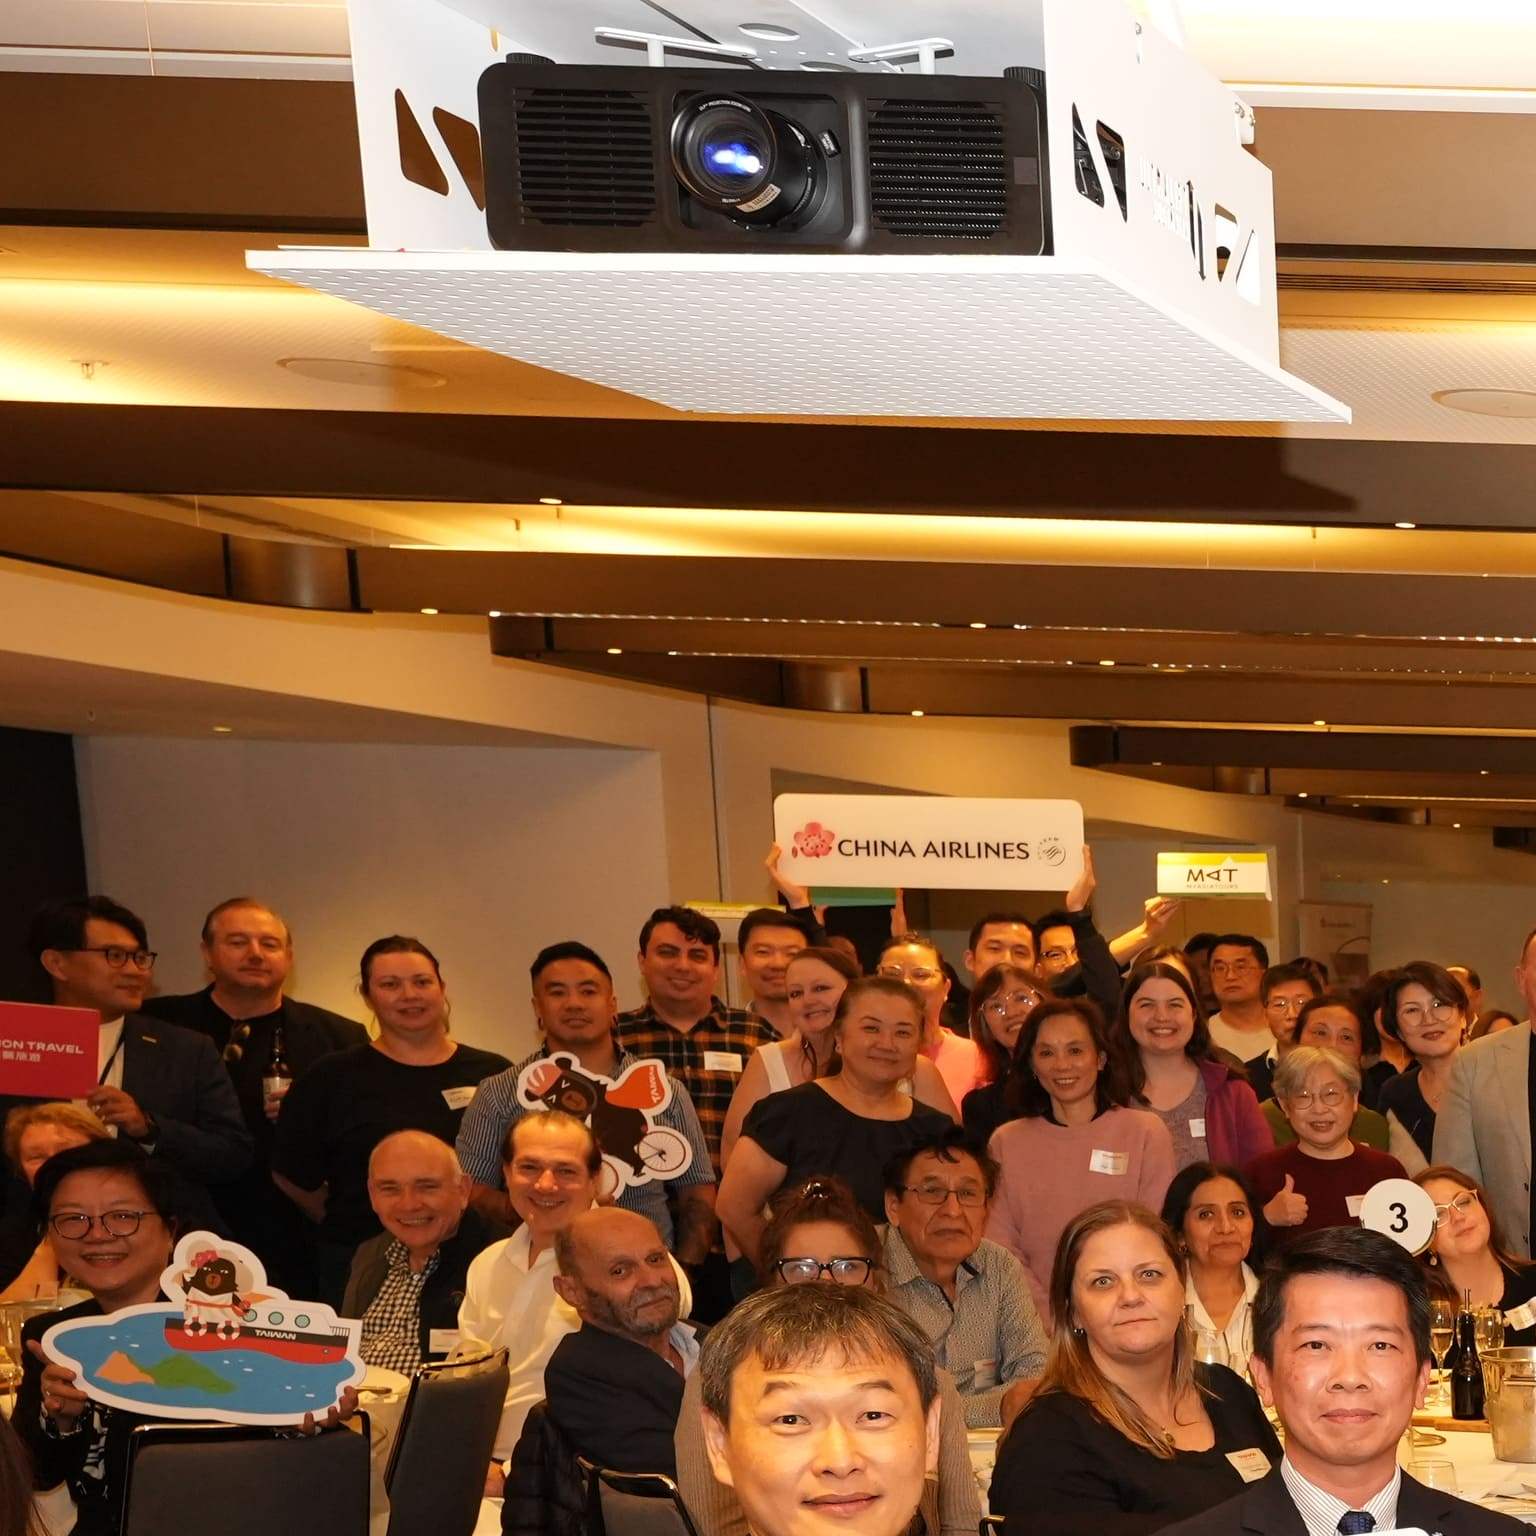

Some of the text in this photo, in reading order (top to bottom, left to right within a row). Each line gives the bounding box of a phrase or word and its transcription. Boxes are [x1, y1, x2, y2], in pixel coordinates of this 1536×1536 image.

[838, 839, 916, 857] CHINA
[922, 841, 1030, 860] AIRLINES
[0, 1039, 84, 1054] ON TRAVEL
[1389, 1202, 1409, 1233] 3
[255, 1329, 297, 1340] TAIWAN
